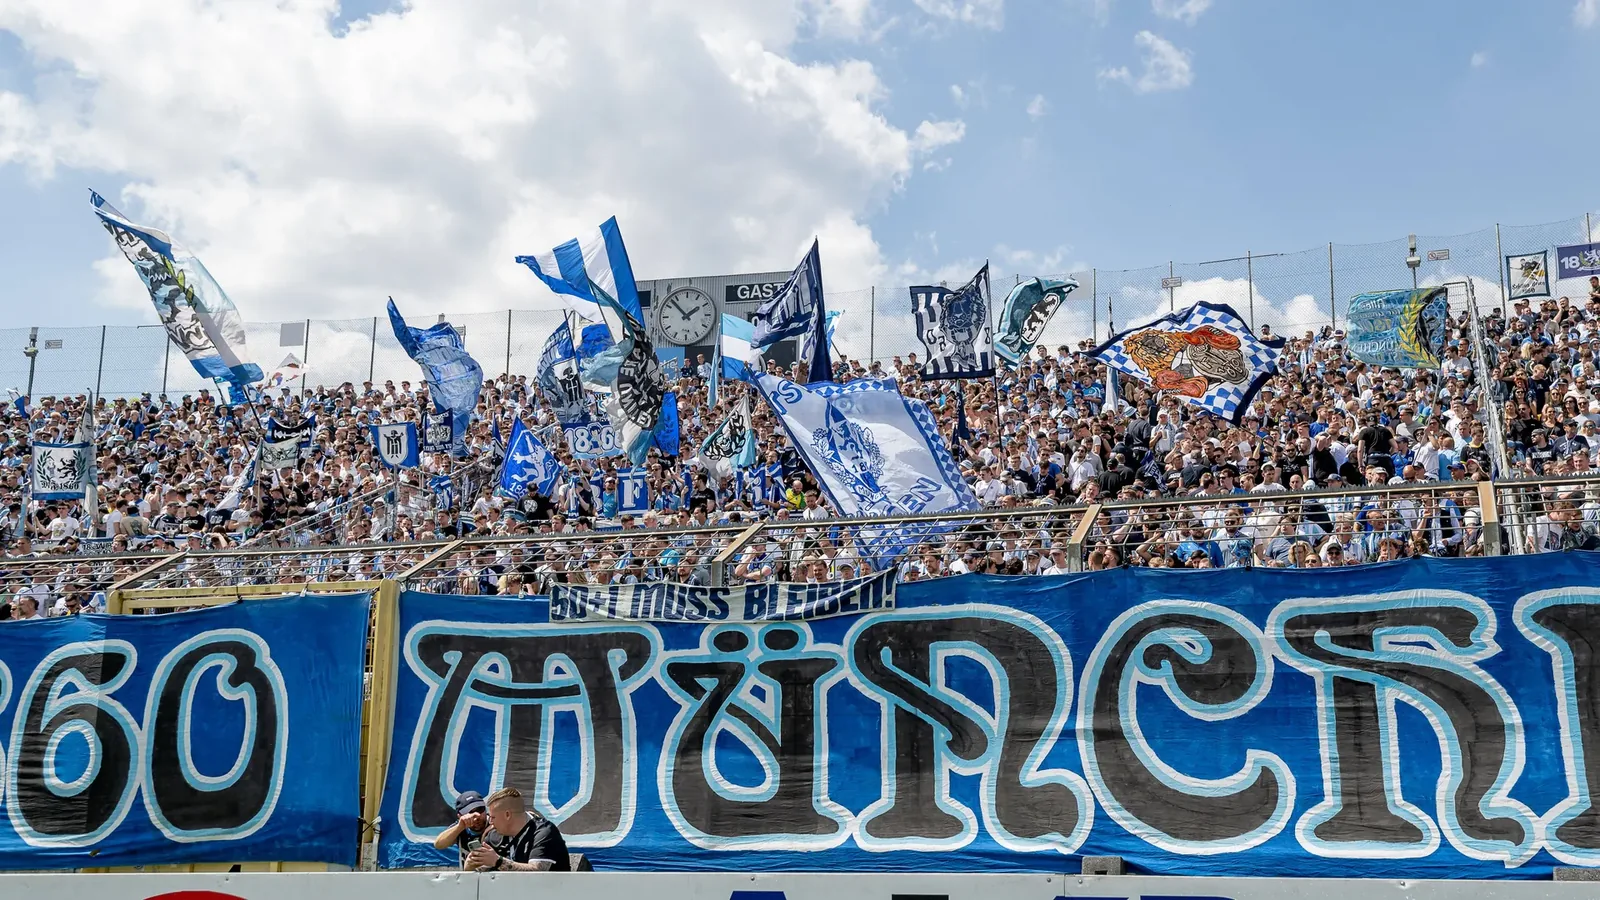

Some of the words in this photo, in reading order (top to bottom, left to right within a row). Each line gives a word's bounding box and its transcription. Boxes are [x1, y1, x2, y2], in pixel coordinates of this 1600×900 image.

[1560, 256, 1580, 269] 18
[629, 581, 730, 620] MUSS
[743, 567, 896, 621] BLEIBEN!
[0, 628, 289, 848] 60
